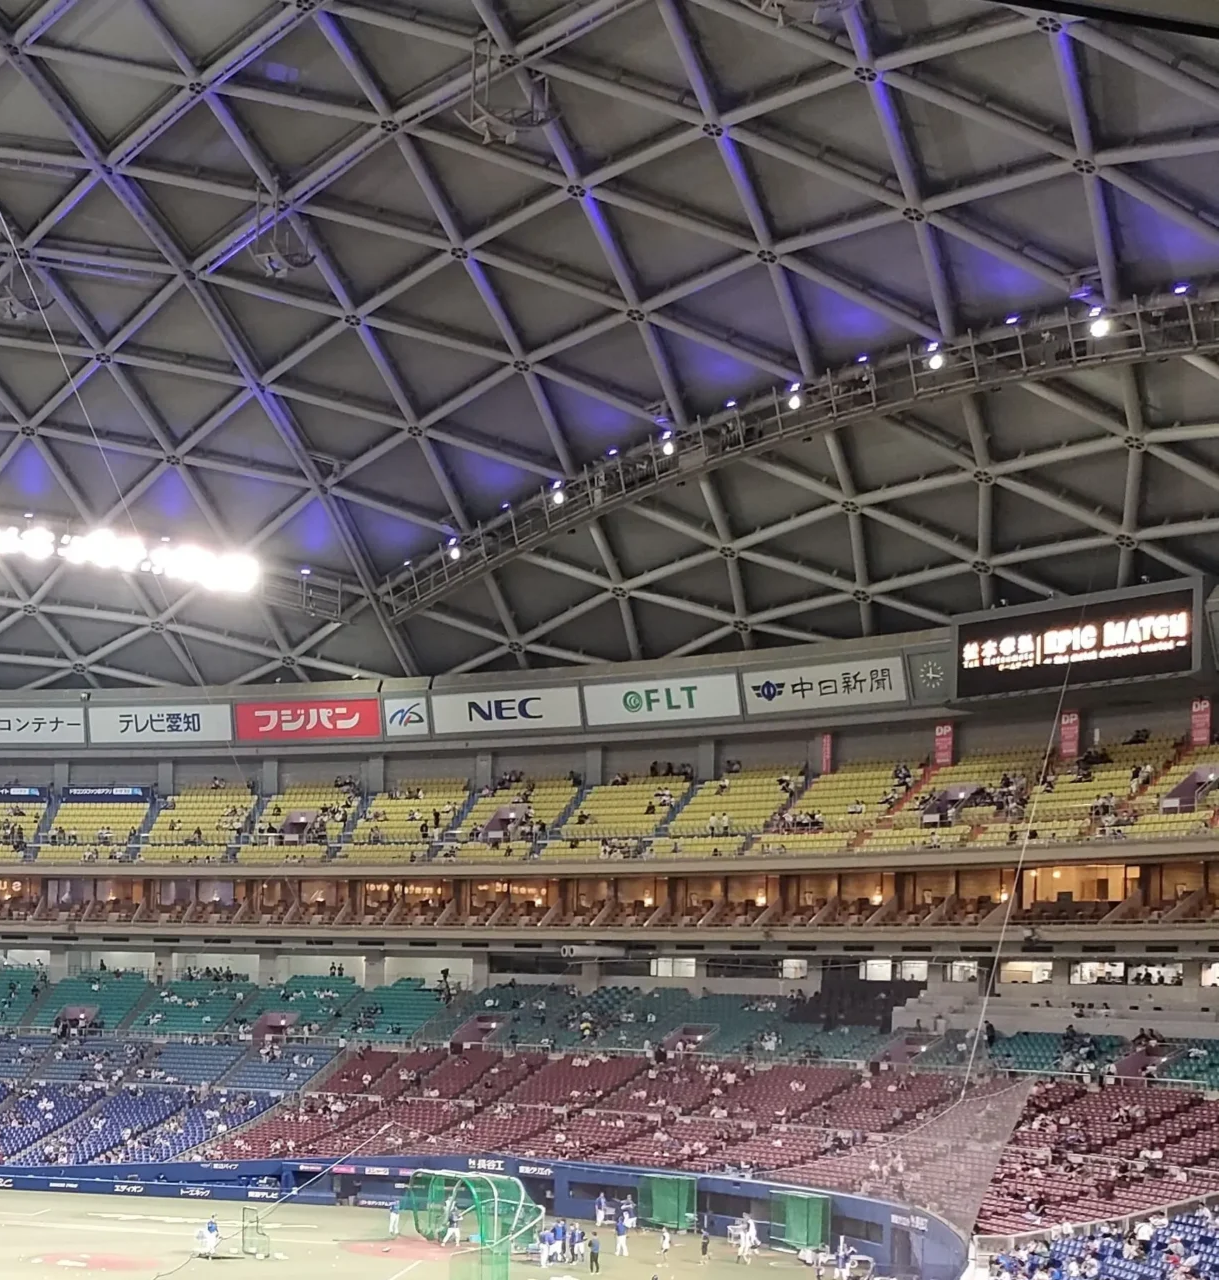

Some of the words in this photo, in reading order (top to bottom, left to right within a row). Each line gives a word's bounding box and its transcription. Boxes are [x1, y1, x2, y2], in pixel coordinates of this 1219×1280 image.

[1044, 625, 1097, 655] EPIC
[1103, 612, 1187, 647] MATCH
[791, 667, 893, 699] 中日新聞
[467, 697, 544, 722] NEC
[645, 685, 698, 712] FLT
[119, 713, 201, 733] テレビ愛知
[254, 707, 360, 733] フジパン
[935, 725, 952, 736] DP
[477, 1160, 505, 1171] 長谷工
[114, 1185, 144, 1193] エディオン
[180, 1188, 210, 1197] トーエネック
